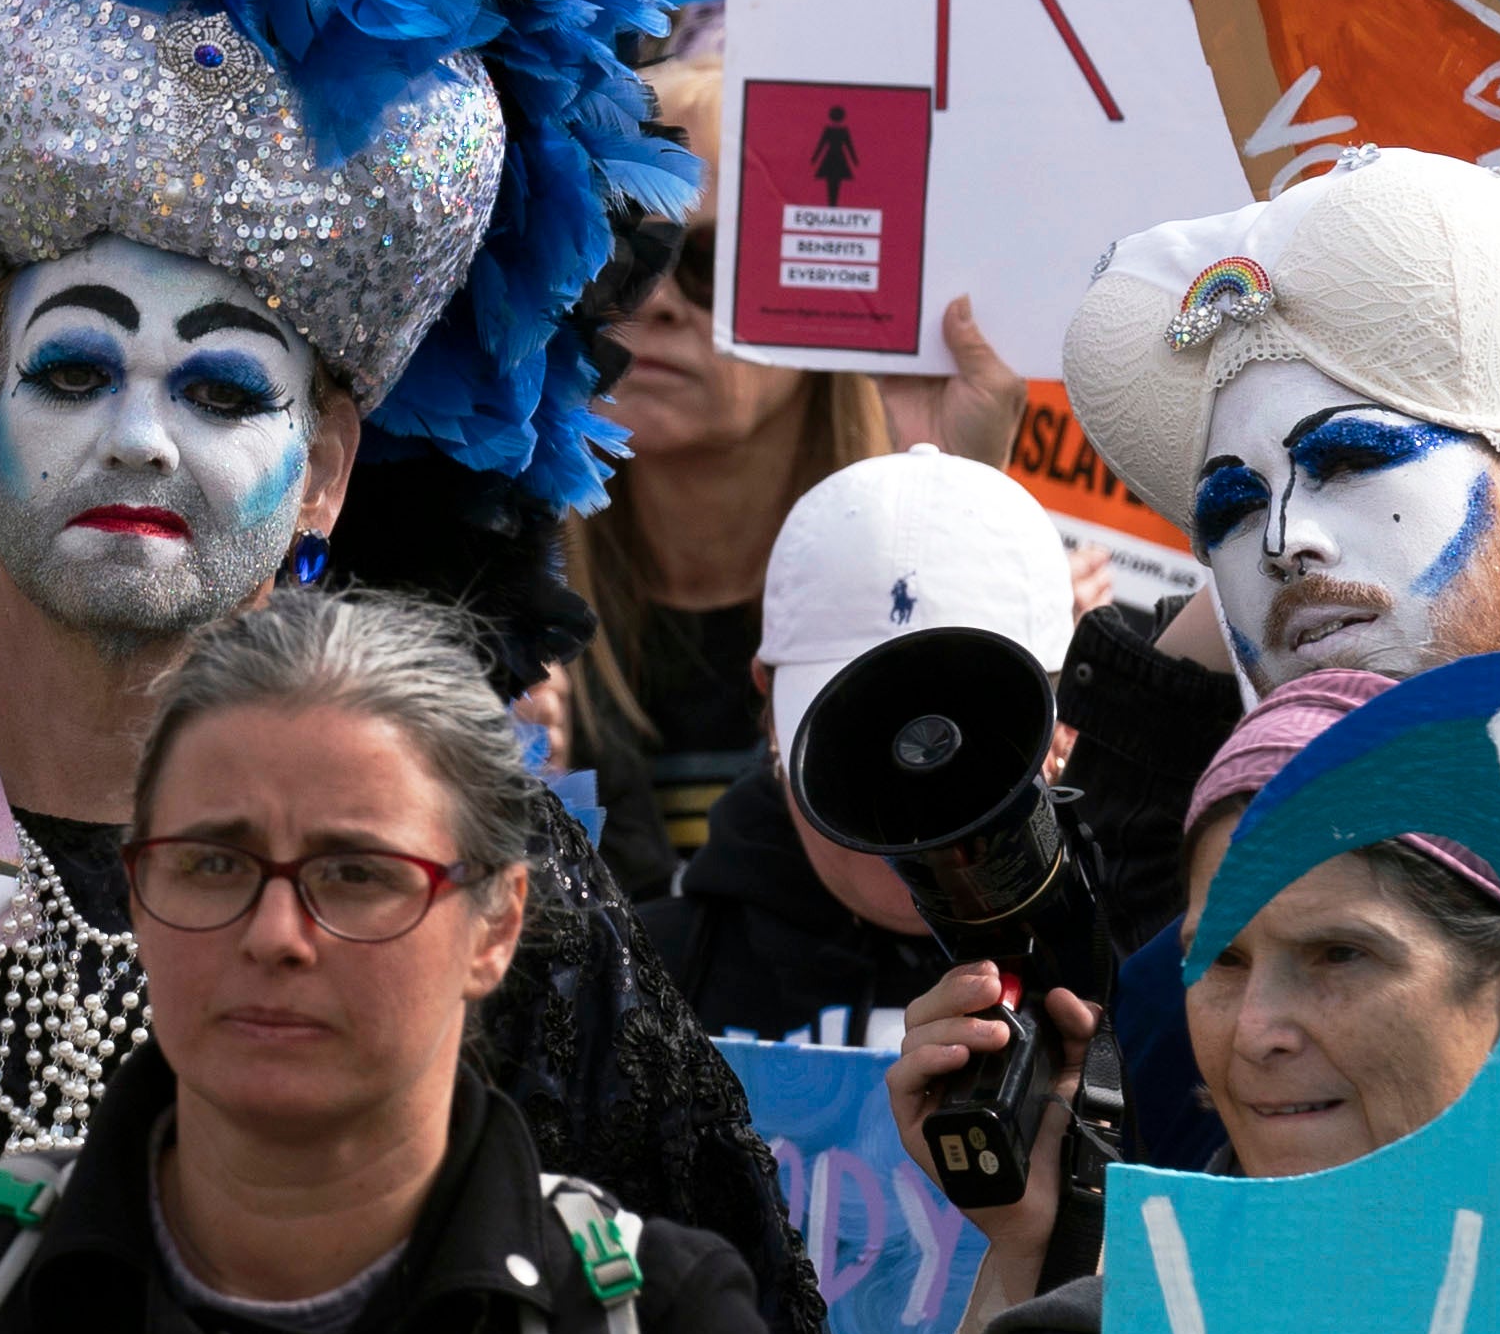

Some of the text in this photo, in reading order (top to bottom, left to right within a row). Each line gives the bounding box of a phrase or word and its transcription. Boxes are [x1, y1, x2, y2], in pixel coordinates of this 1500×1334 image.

[793, 211, 872, 228] EQUALITY
[796, 240, 866, 257] BENEFITS
[787, 268, 871, 285] EVERYONE
